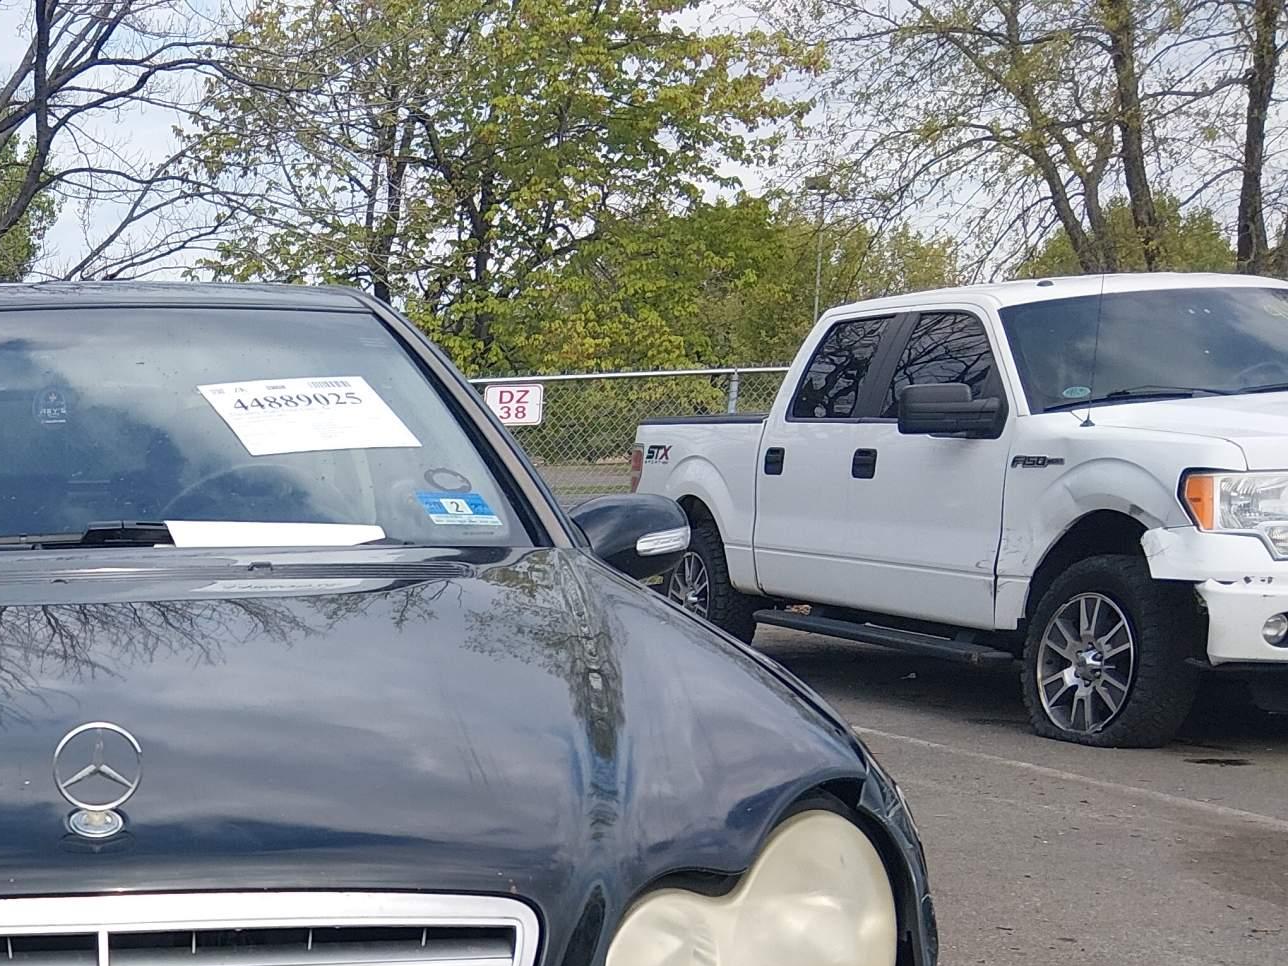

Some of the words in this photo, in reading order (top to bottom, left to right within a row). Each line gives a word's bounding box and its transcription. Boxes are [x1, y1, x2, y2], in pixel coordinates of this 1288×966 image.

[233, 392, 362, 410] 44889025
[498, 389, 530, 405] DZ
[499, 405, 527, 420] 38
[645, 444, 672, 460] STX
[450, 500, 464, 513] 2
